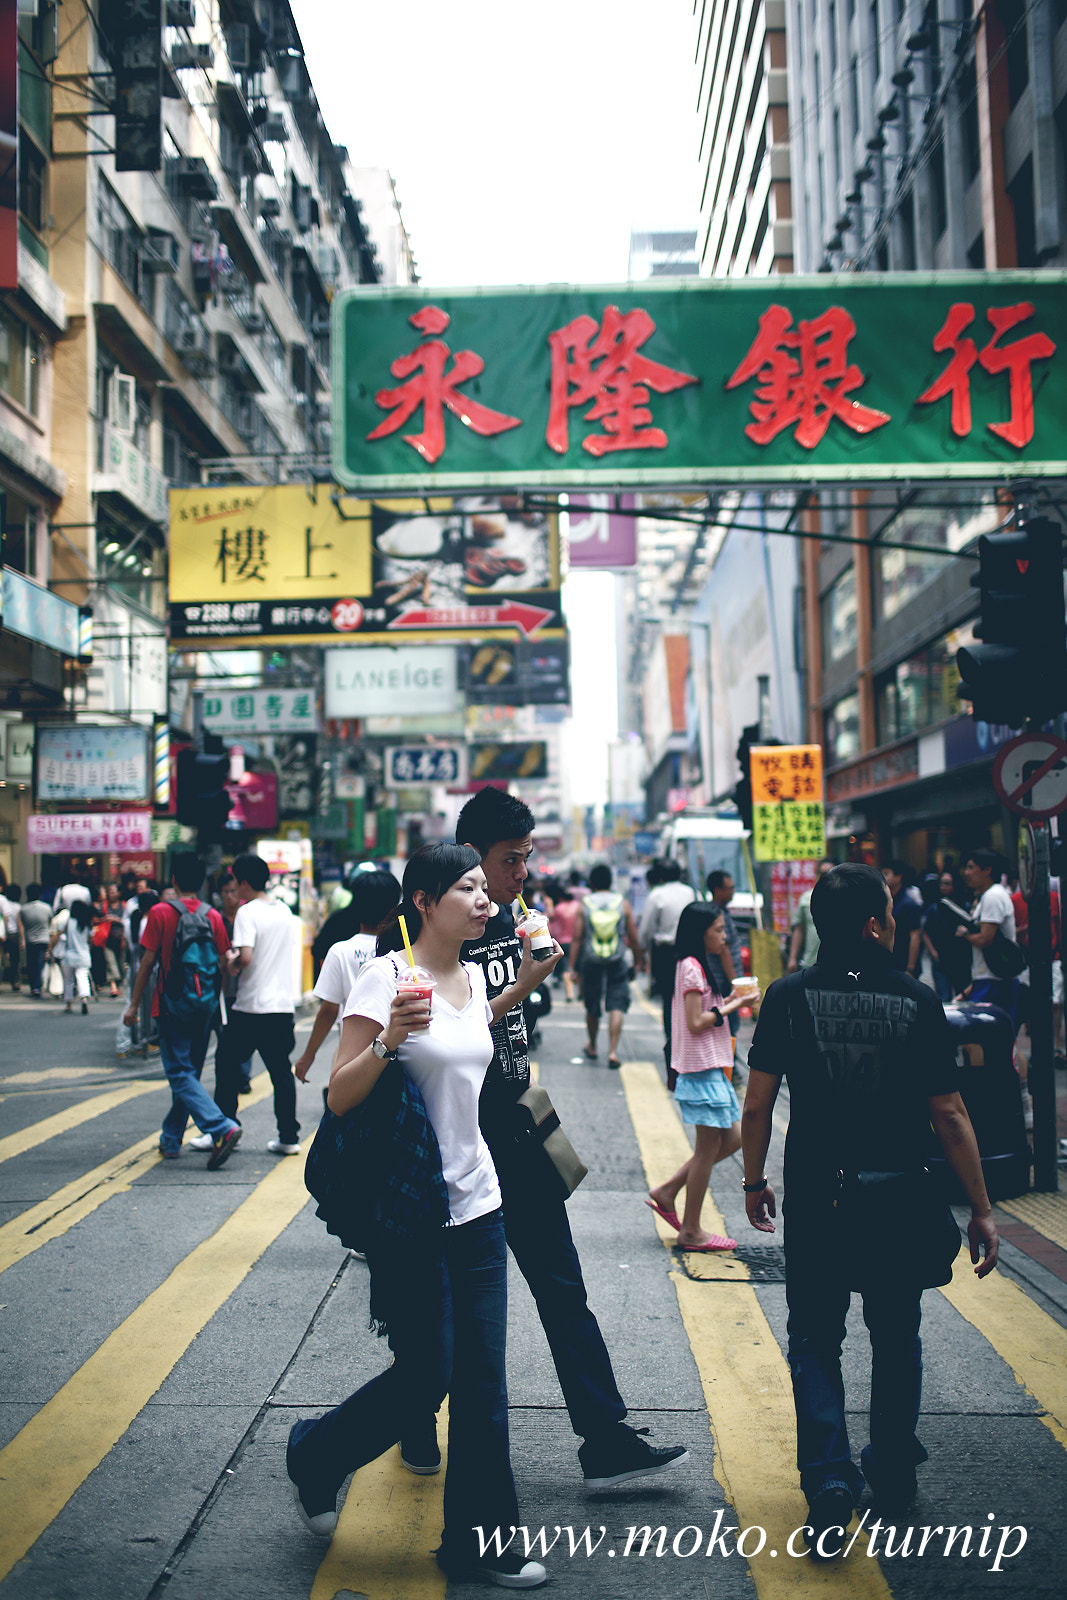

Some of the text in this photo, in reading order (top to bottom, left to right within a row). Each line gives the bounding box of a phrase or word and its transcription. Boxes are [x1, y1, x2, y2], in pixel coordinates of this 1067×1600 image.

[365, 302, 1056, 463] 永隆銀行
[214, 525, 338, 584] 樓上
[333, 602, 362, 628] 20
[36, 815, 142, 832] SUPER NAIL
[482, 956, 517, 986] 01
